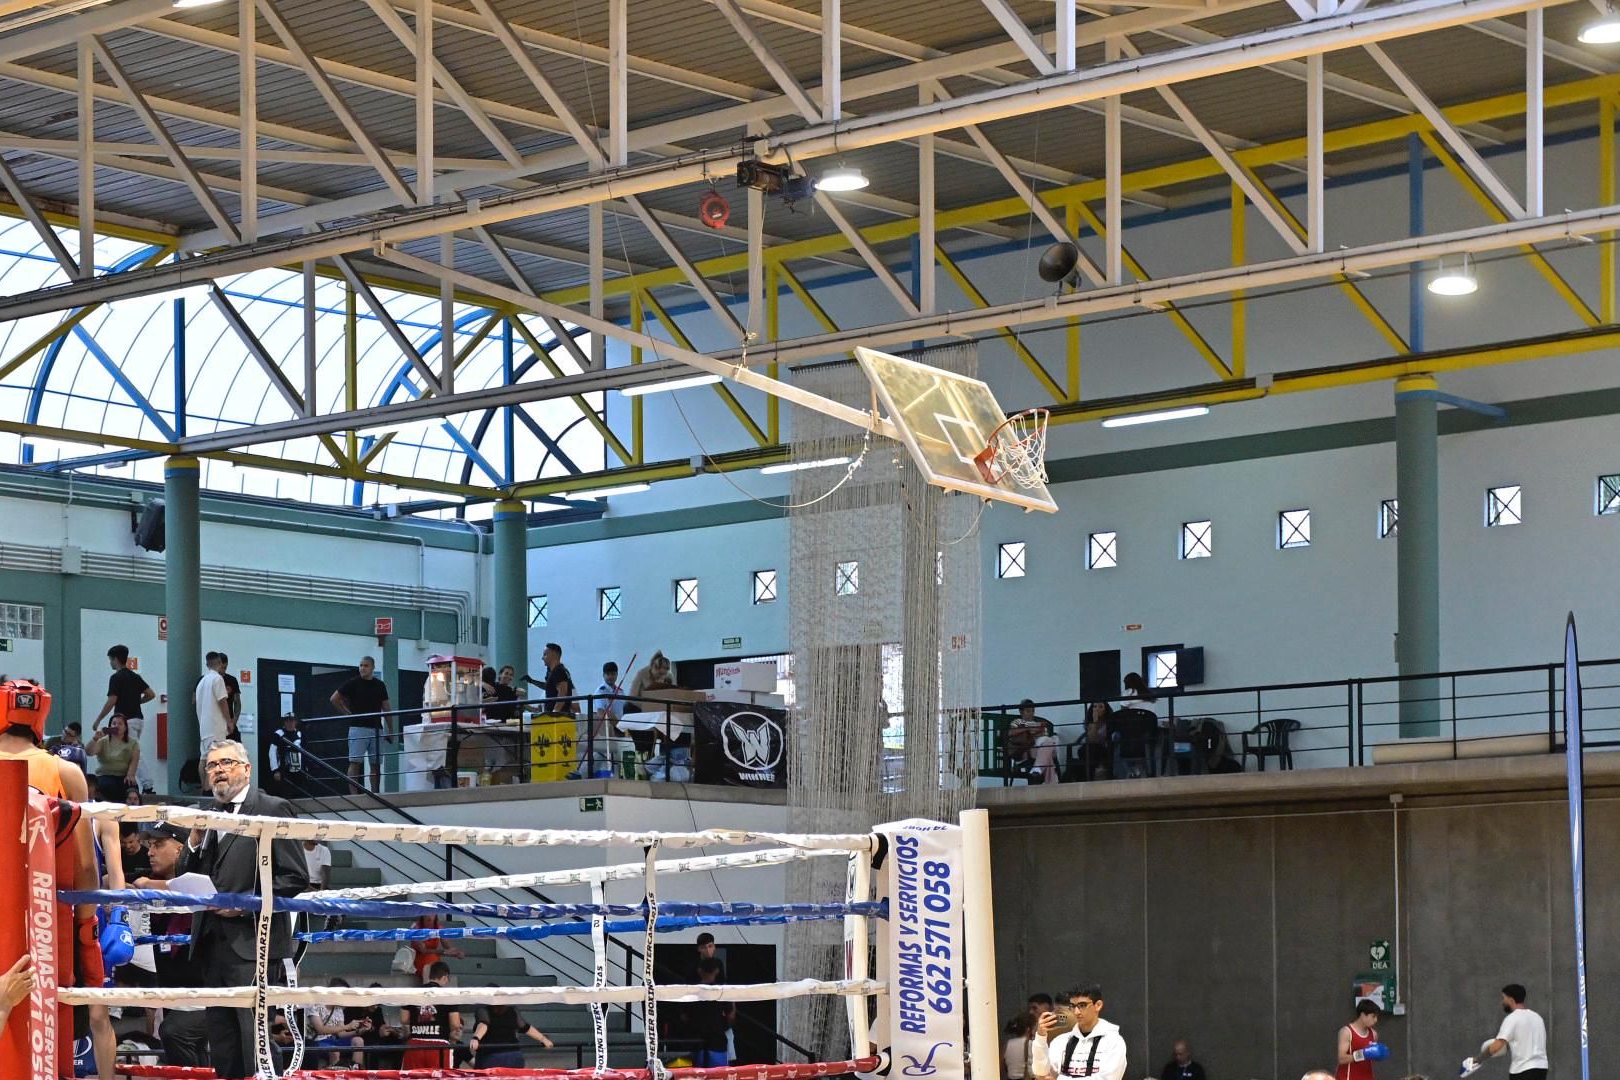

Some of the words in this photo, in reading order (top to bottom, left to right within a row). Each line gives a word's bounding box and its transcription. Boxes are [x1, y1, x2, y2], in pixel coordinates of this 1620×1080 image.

[896, 835, 919, 923] SERVICIOS
[923, 860, 951, 913] 058
[33, 871, 55, 990] REFORMAS
[44, 995, 55, 1010] Y
[900, 924, 919, 938] Y
[924, 920, 951, 961] 571
[258, 915, 269, 1010] INTERCANARIAS
[1372, 962, 1388, 970] DEA
[646, 980, 656, 1017] BOXING
[899, 940, 926, 1034] REFORMAS
[927, 963, 953, 1014] 662
[259, 1013, 267, 1056] BOXING
[597, 1037, 606, 1070] BOXING
